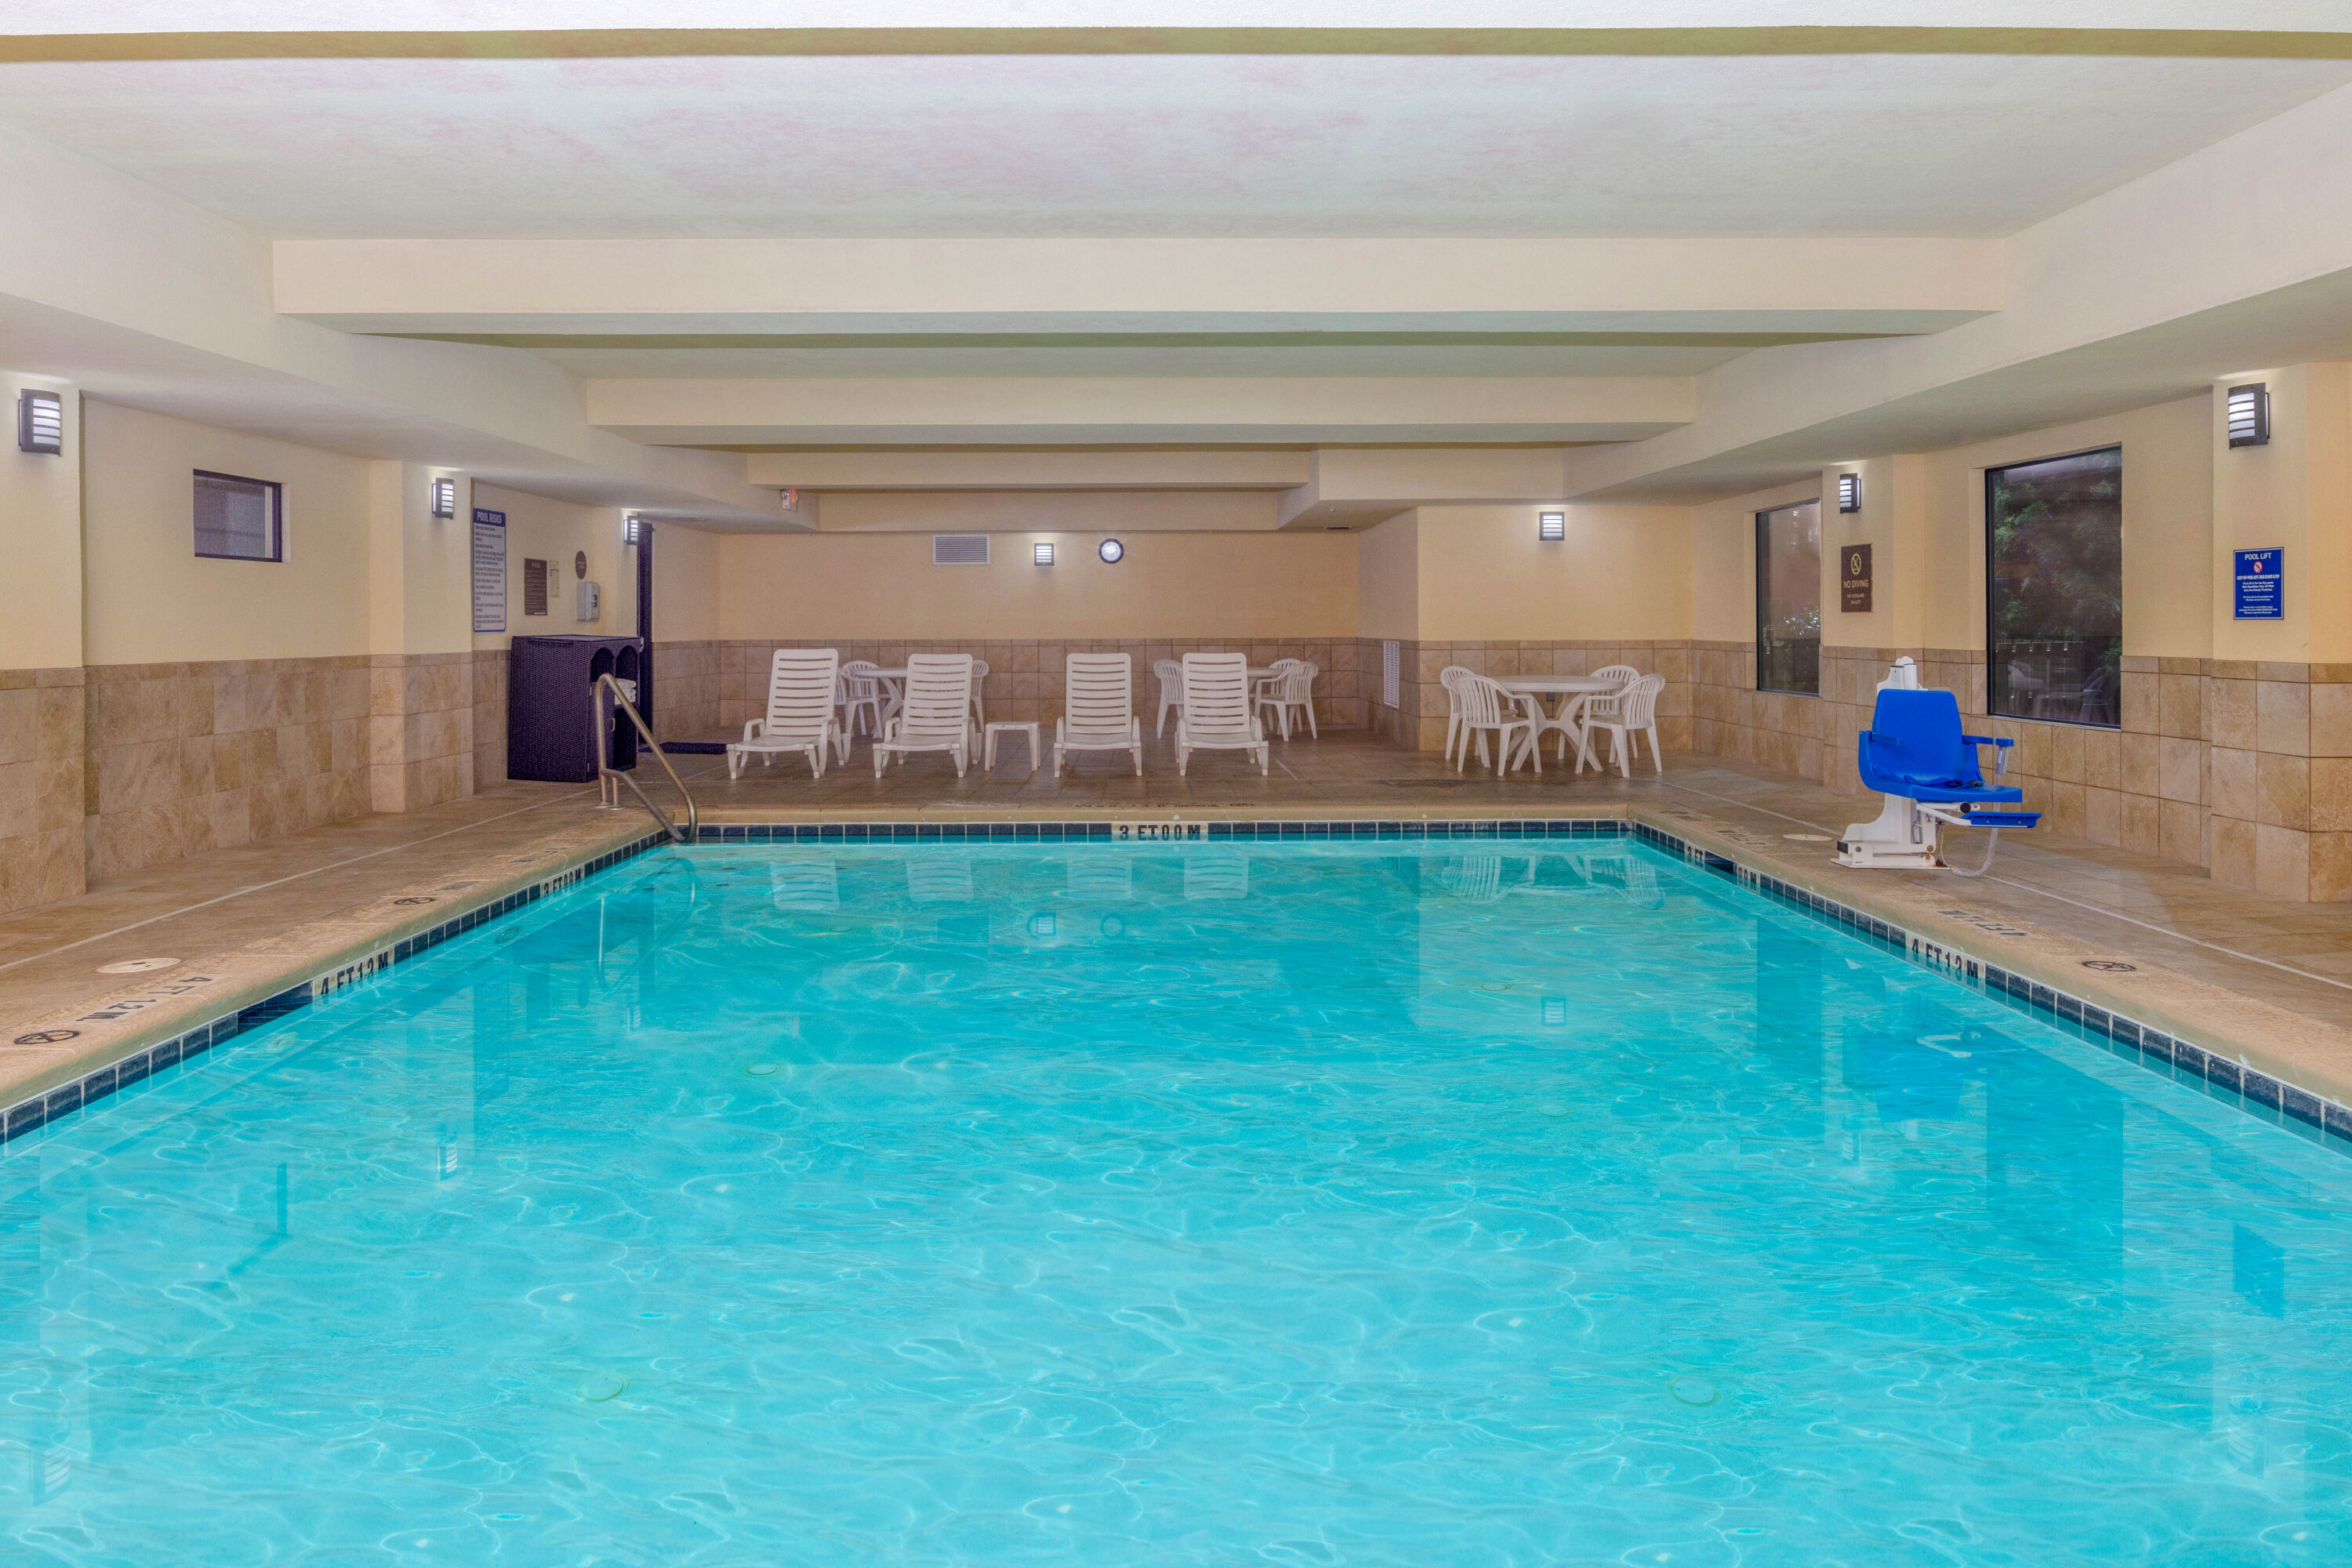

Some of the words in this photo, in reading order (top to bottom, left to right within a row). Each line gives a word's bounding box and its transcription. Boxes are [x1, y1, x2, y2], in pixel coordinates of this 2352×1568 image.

[477, 511, 488, 522] POOL
[489, 513, 502, 524] RISKS
[1852, 579, 1869, 588] DIVING
